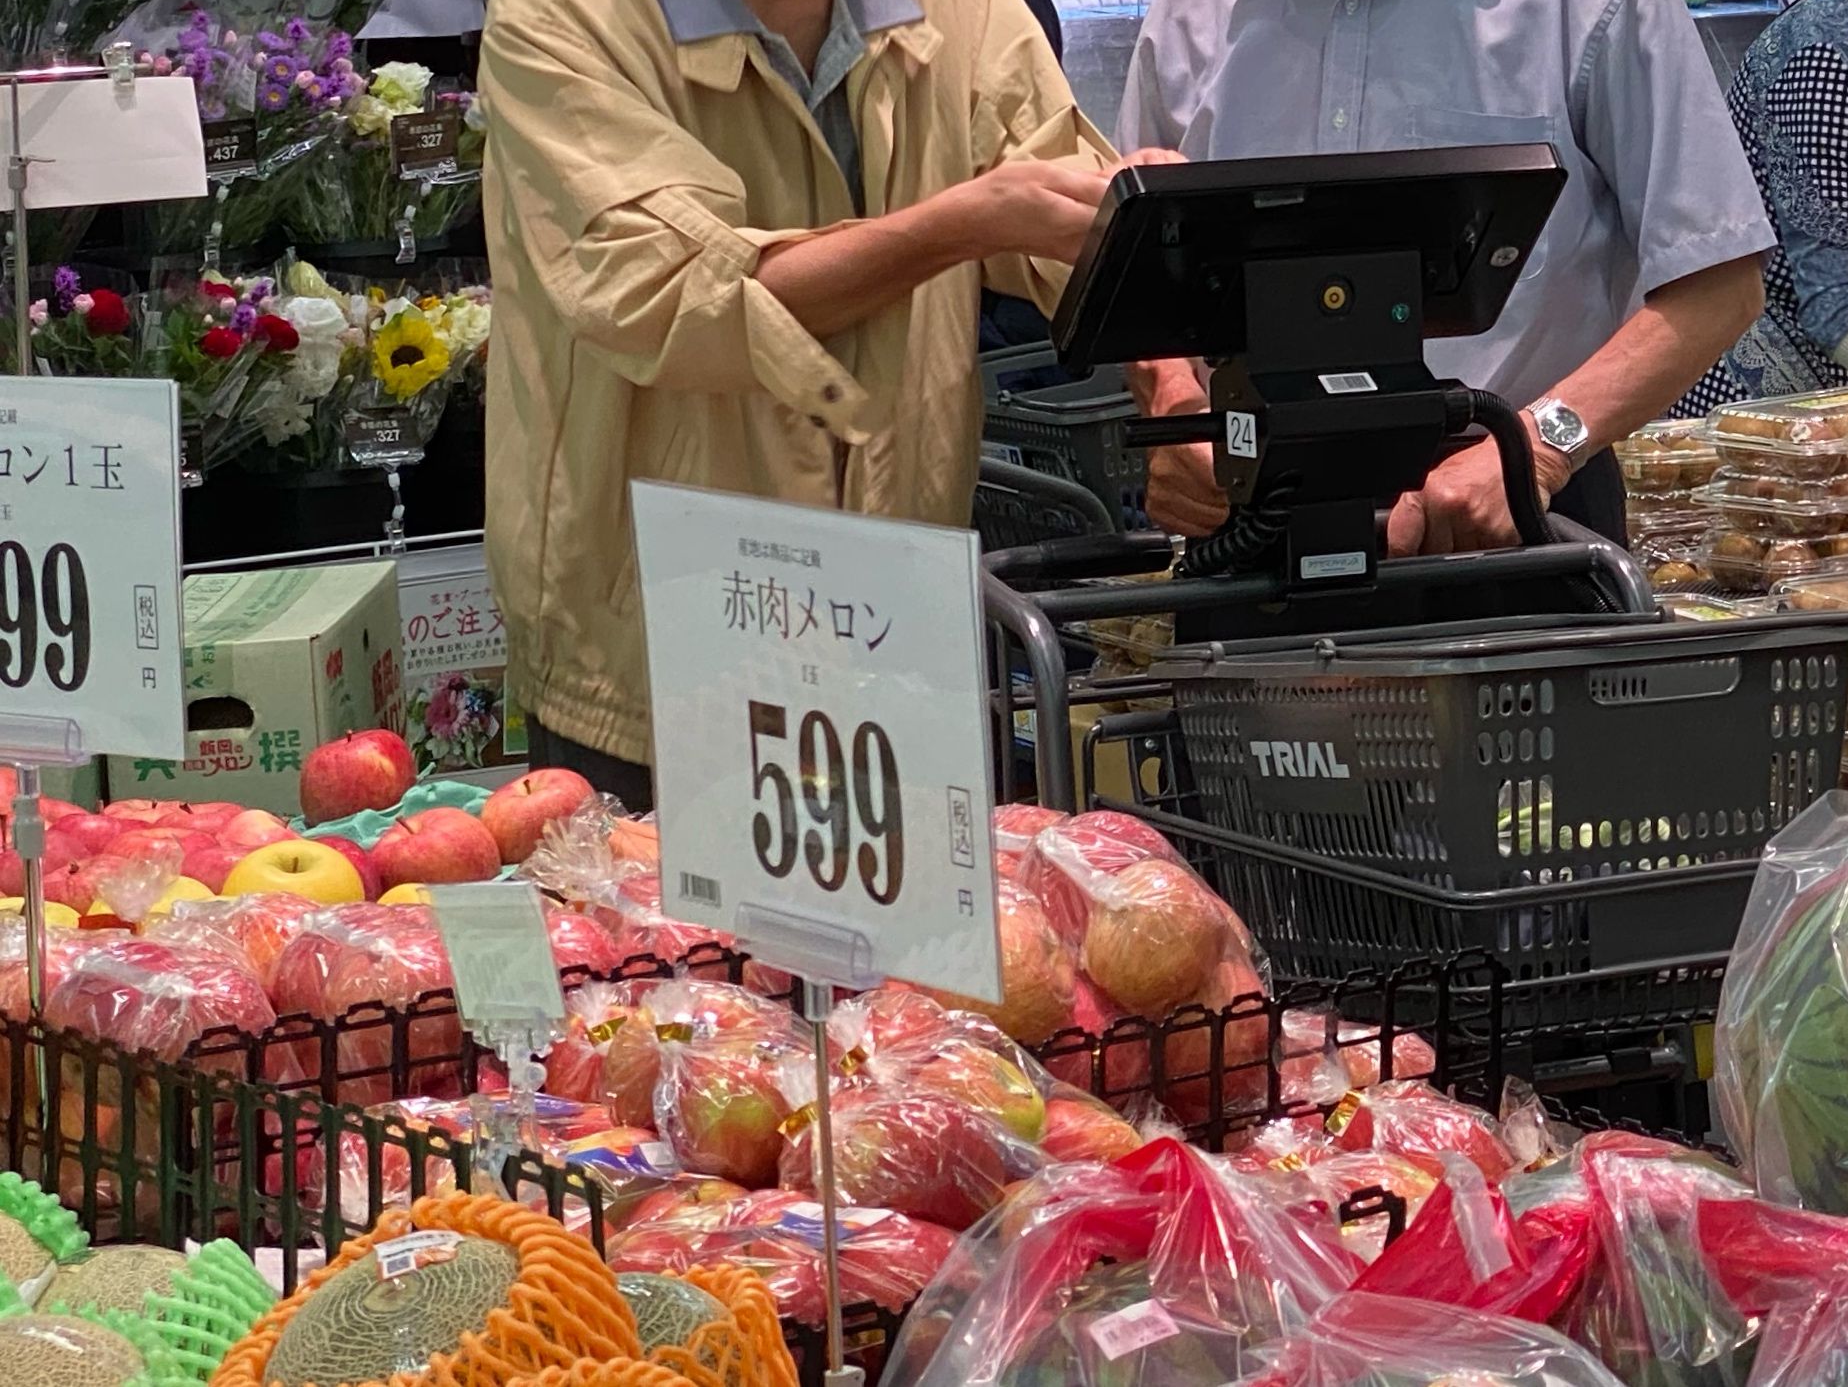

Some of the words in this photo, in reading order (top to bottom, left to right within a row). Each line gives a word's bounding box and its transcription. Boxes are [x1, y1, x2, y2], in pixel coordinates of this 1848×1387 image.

[213, 145, 239, 161] 437
[421, 133, 443, 148] 327
[376, 429, 400, 443] 327
[1231, 416, 1253, 452] 24
[138, 596, 155, 640] 税込
[722, 570, 893, 652] 赤肉メロン
[142, 667, 156, 689] 円
[1249, 740, 1351, 780] TRIAL
[748, 700, 904, 906] 599
[958, 889, 974, 916] 円
